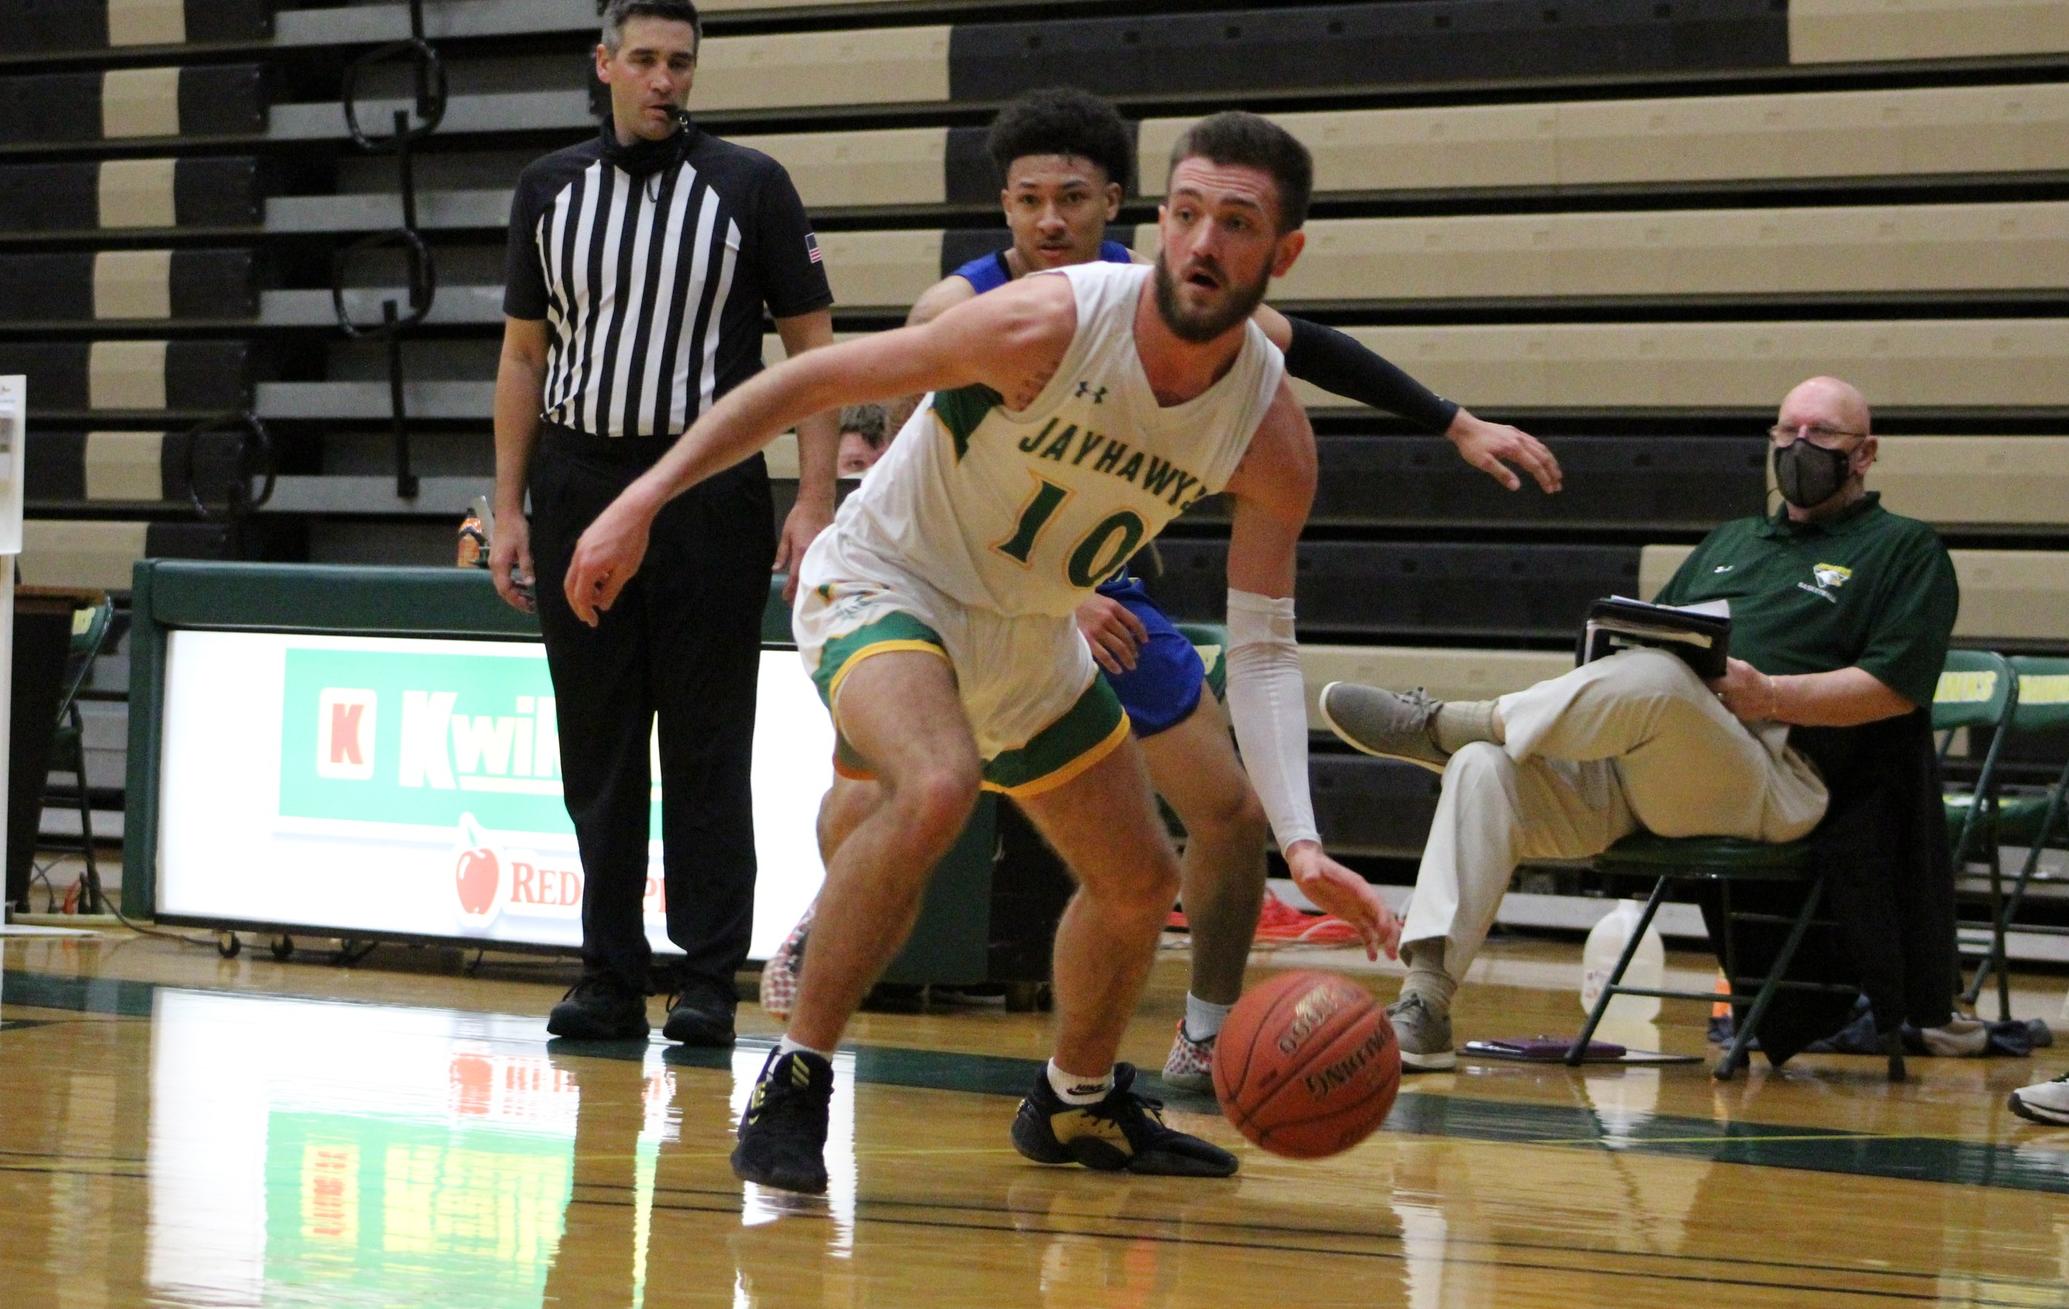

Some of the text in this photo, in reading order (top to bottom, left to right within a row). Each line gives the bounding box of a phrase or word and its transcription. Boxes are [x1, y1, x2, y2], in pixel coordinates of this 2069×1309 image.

[992, 472, 1148, 589] 10
[330, 703, 364, 764] K
[510, 861, 582, 906] RED
